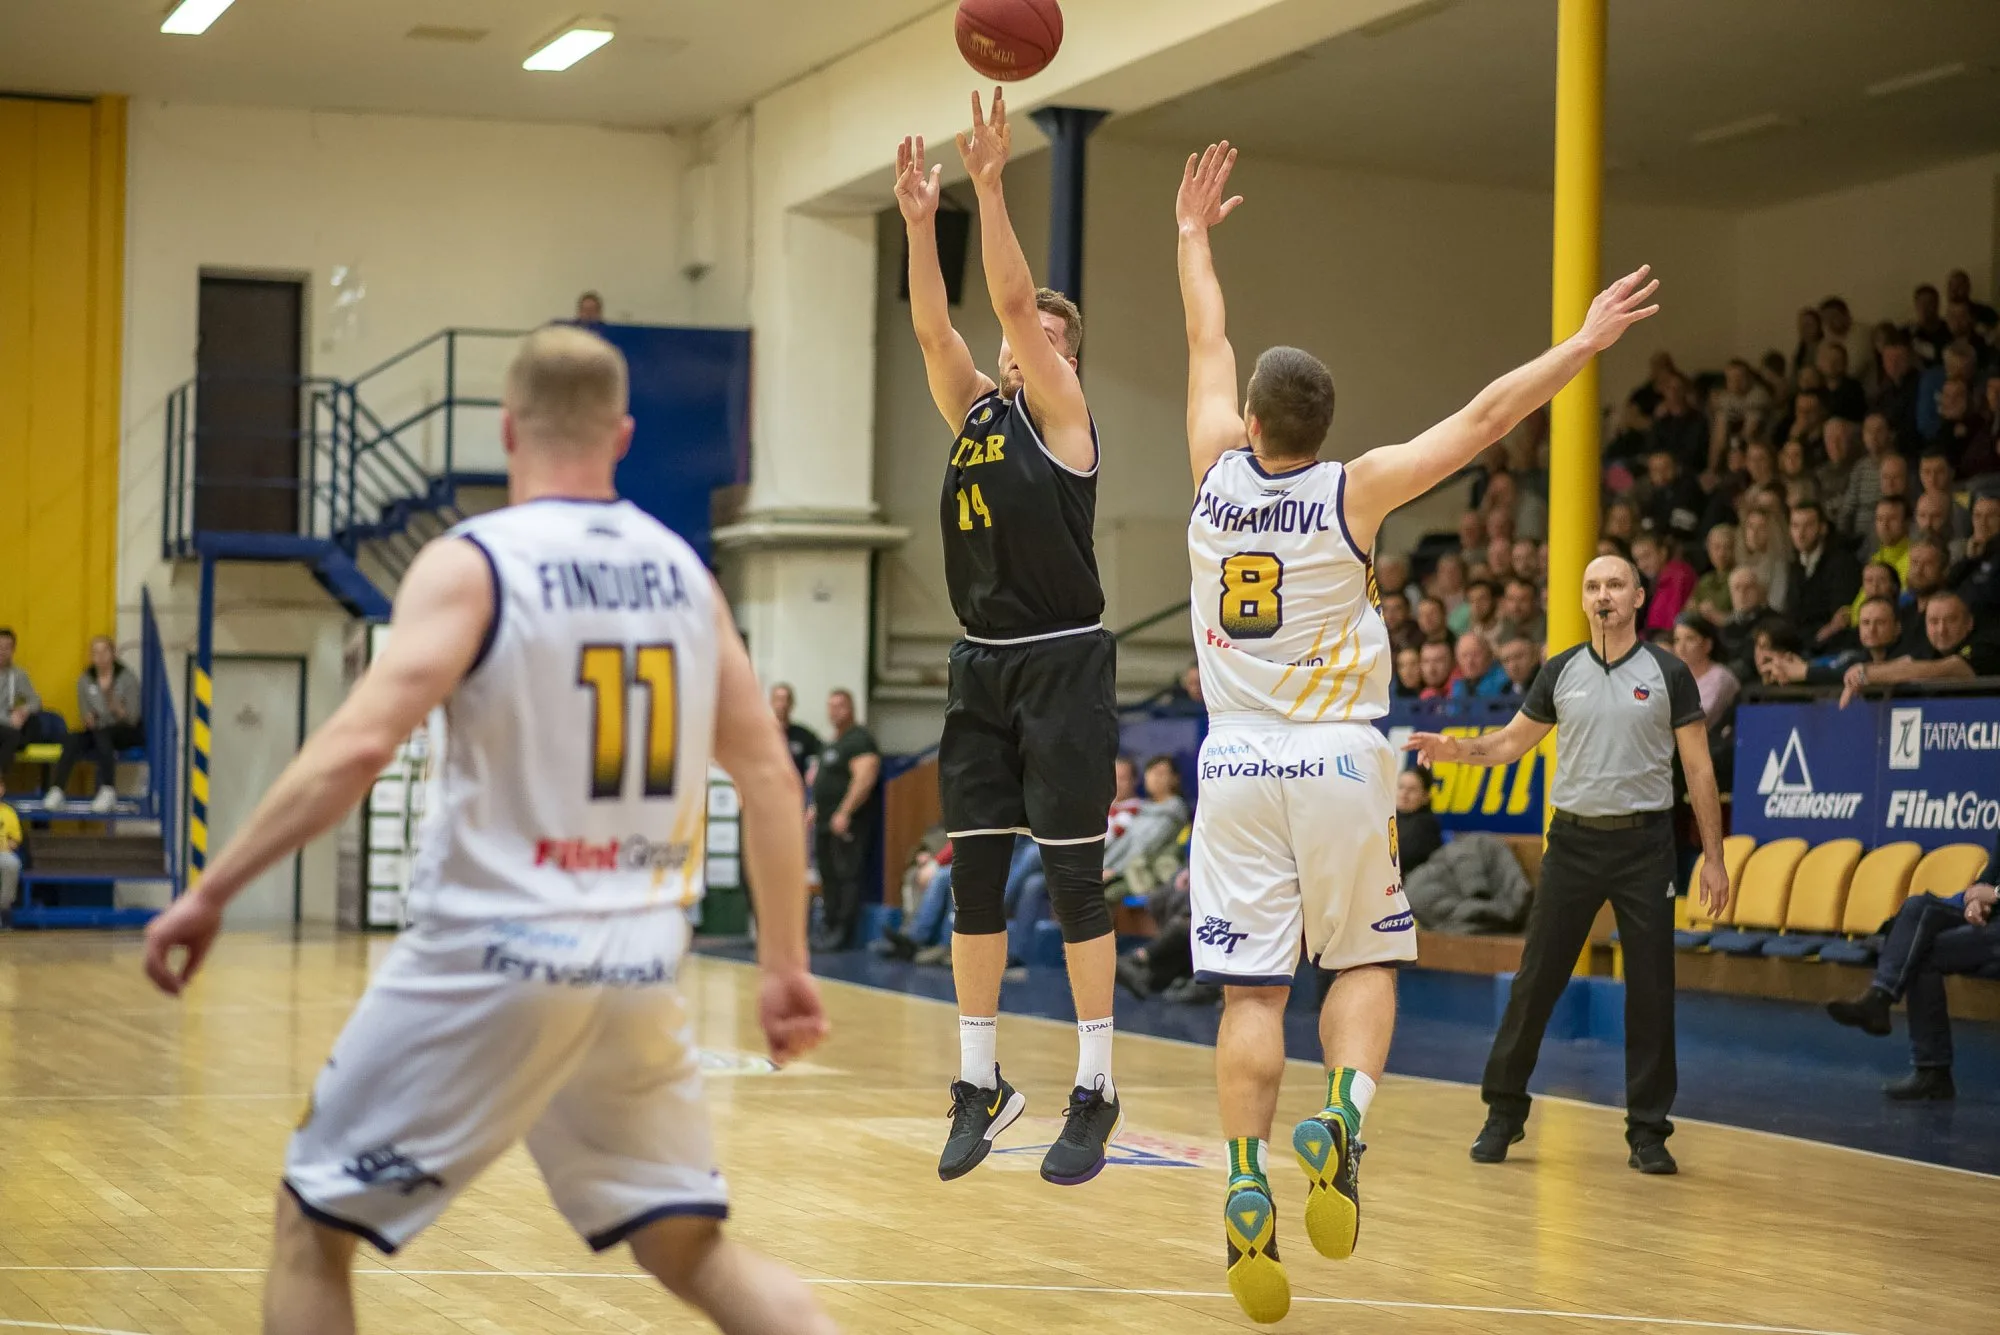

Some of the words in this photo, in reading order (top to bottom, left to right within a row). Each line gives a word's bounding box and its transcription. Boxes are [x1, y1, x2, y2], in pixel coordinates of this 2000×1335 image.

[956, 483, 992, 531] 14
[1219, 551, 1284, 640] 8
[574, 642, 678, 799] 11
[1923, 722, 2000, 751] TATRACLI
[1764, 792, 1863, 820] CHEMOSVIT
[1886, 789, 2000, 832] FlintGro
